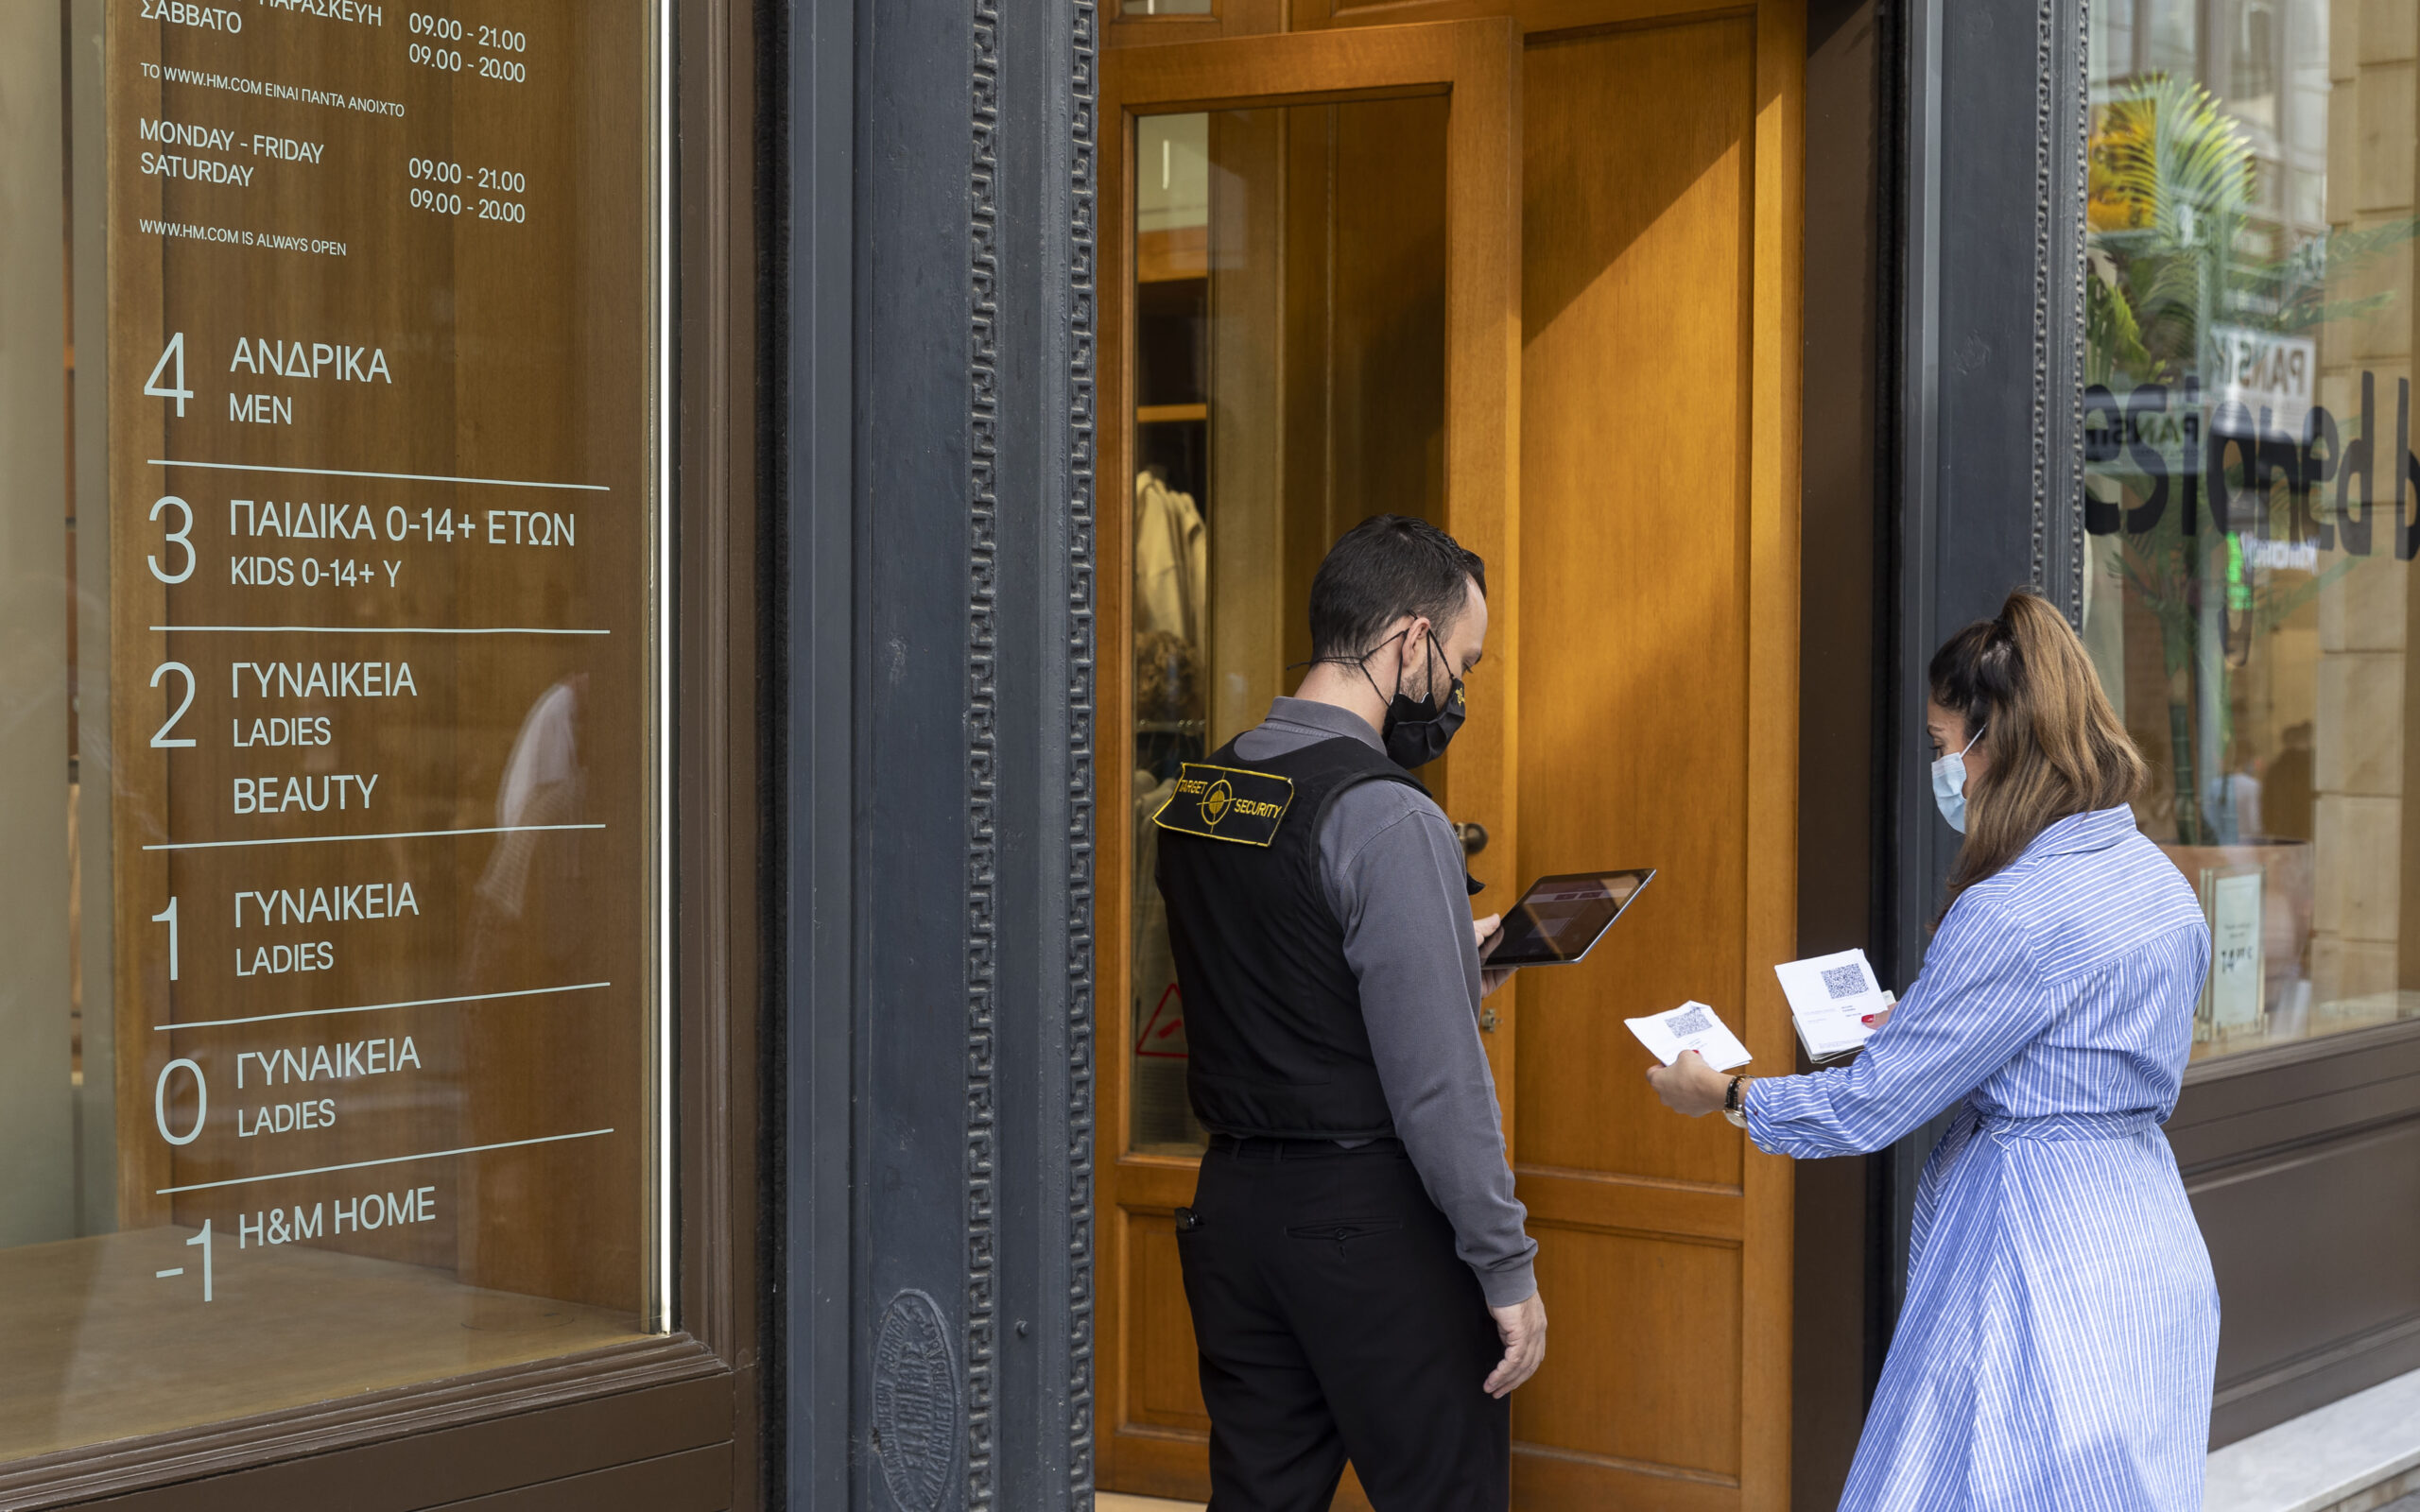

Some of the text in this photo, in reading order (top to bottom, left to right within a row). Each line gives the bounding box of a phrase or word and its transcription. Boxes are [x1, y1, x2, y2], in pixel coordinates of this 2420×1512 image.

[140, 0, 242, 34] ΣΑΒΒΑΤΟ
[259, 0, 382, 26] ΡΑΣΚΕΥΗ
[408, 12, 462, 41] 09.00
[478, 25, 527, 53] 21.00
[408, 43, 462, 72] 09.00
[479, 56, 526, 83] 20.00
[141, 62, 405, 118] ΤΟ WWW.HM.COM ΕΙΝΑΙ ΠΑΝΤΑ ΑΝΟΙΧΤΟ
[140, 117, 235, 152] MONDAY
[253, 134, 324, 164] FRIDAY
[141, 151, 254, 187] SATURDAY
[408, 157, 462, 184] 09.00
[477, 167, 526, 194] 21.00
[409, 188, 462, 215] 09.00
[478, 198, 526, 224] 20.00
[139, 218, 347, 256] WWW.HM.COM IS ALWAYS OPEN
[143, 332, 195, 418] 4
[230, 336, 392, 385] ΑΝΔΡΙΚΑ
[229, 392, 292, 424] MEN
[147, 495, 197, 585] 3
[230, 499, 575, 546] ΠΑΙΔΙΚΑ 0-14+ ΕΤΩΝ
[231, 556, 402, 588] KIDS 0-14+ Y
[232, 662, 418, 698] ΓΥΝΑΙΚΕΙΑ
[149, 661, 197, 748] 2
[233, 716, 332, 747] LADIES
[233, 773, 379, 815] BEAUTY
[1178, 780, 1283, 819] TARGET SECURITY
[234, 882, 420, 928] ΓΥΝΑΙΚΕΙΑ
[151, 896, 179, 981] 1
[235, 940, 335, 977] LADIES
[236, 1036, 422, 1090] ΓΥΝΑΙΚΕΙΑ
[154, 1057, 207, 1146] 0
[237, 1098, 337, 1138] LADIES
[239, 1185, 437, 1250] H&M HOME
